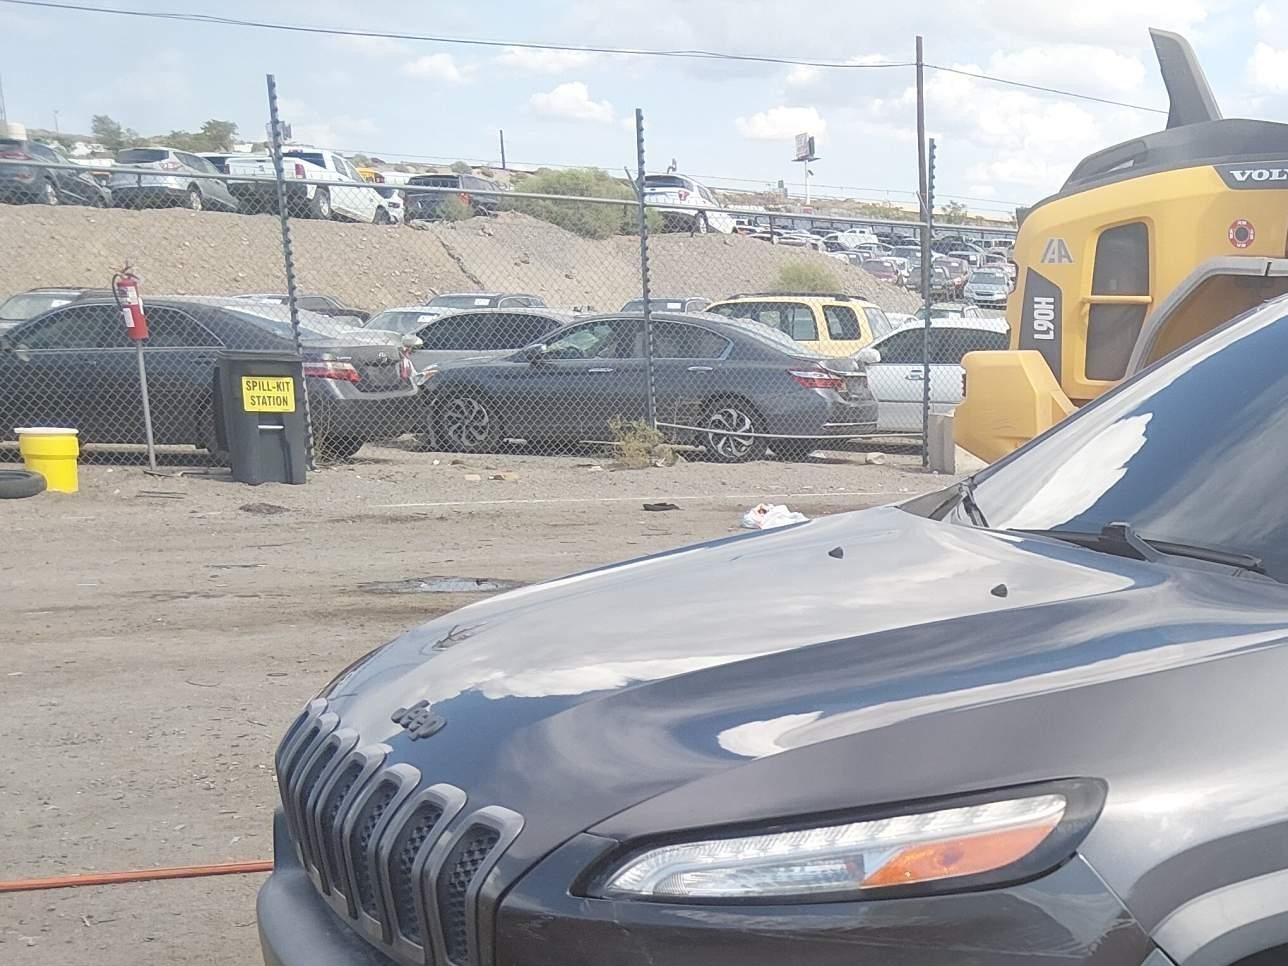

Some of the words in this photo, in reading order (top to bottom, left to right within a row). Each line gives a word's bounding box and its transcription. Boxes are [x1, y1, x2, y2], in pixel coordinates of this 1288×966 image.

[1033, 297, 1055, 340] L90H
[245, 380, 291, 392] SPILL-KIT
[250, 395, 289, 406] STATION
